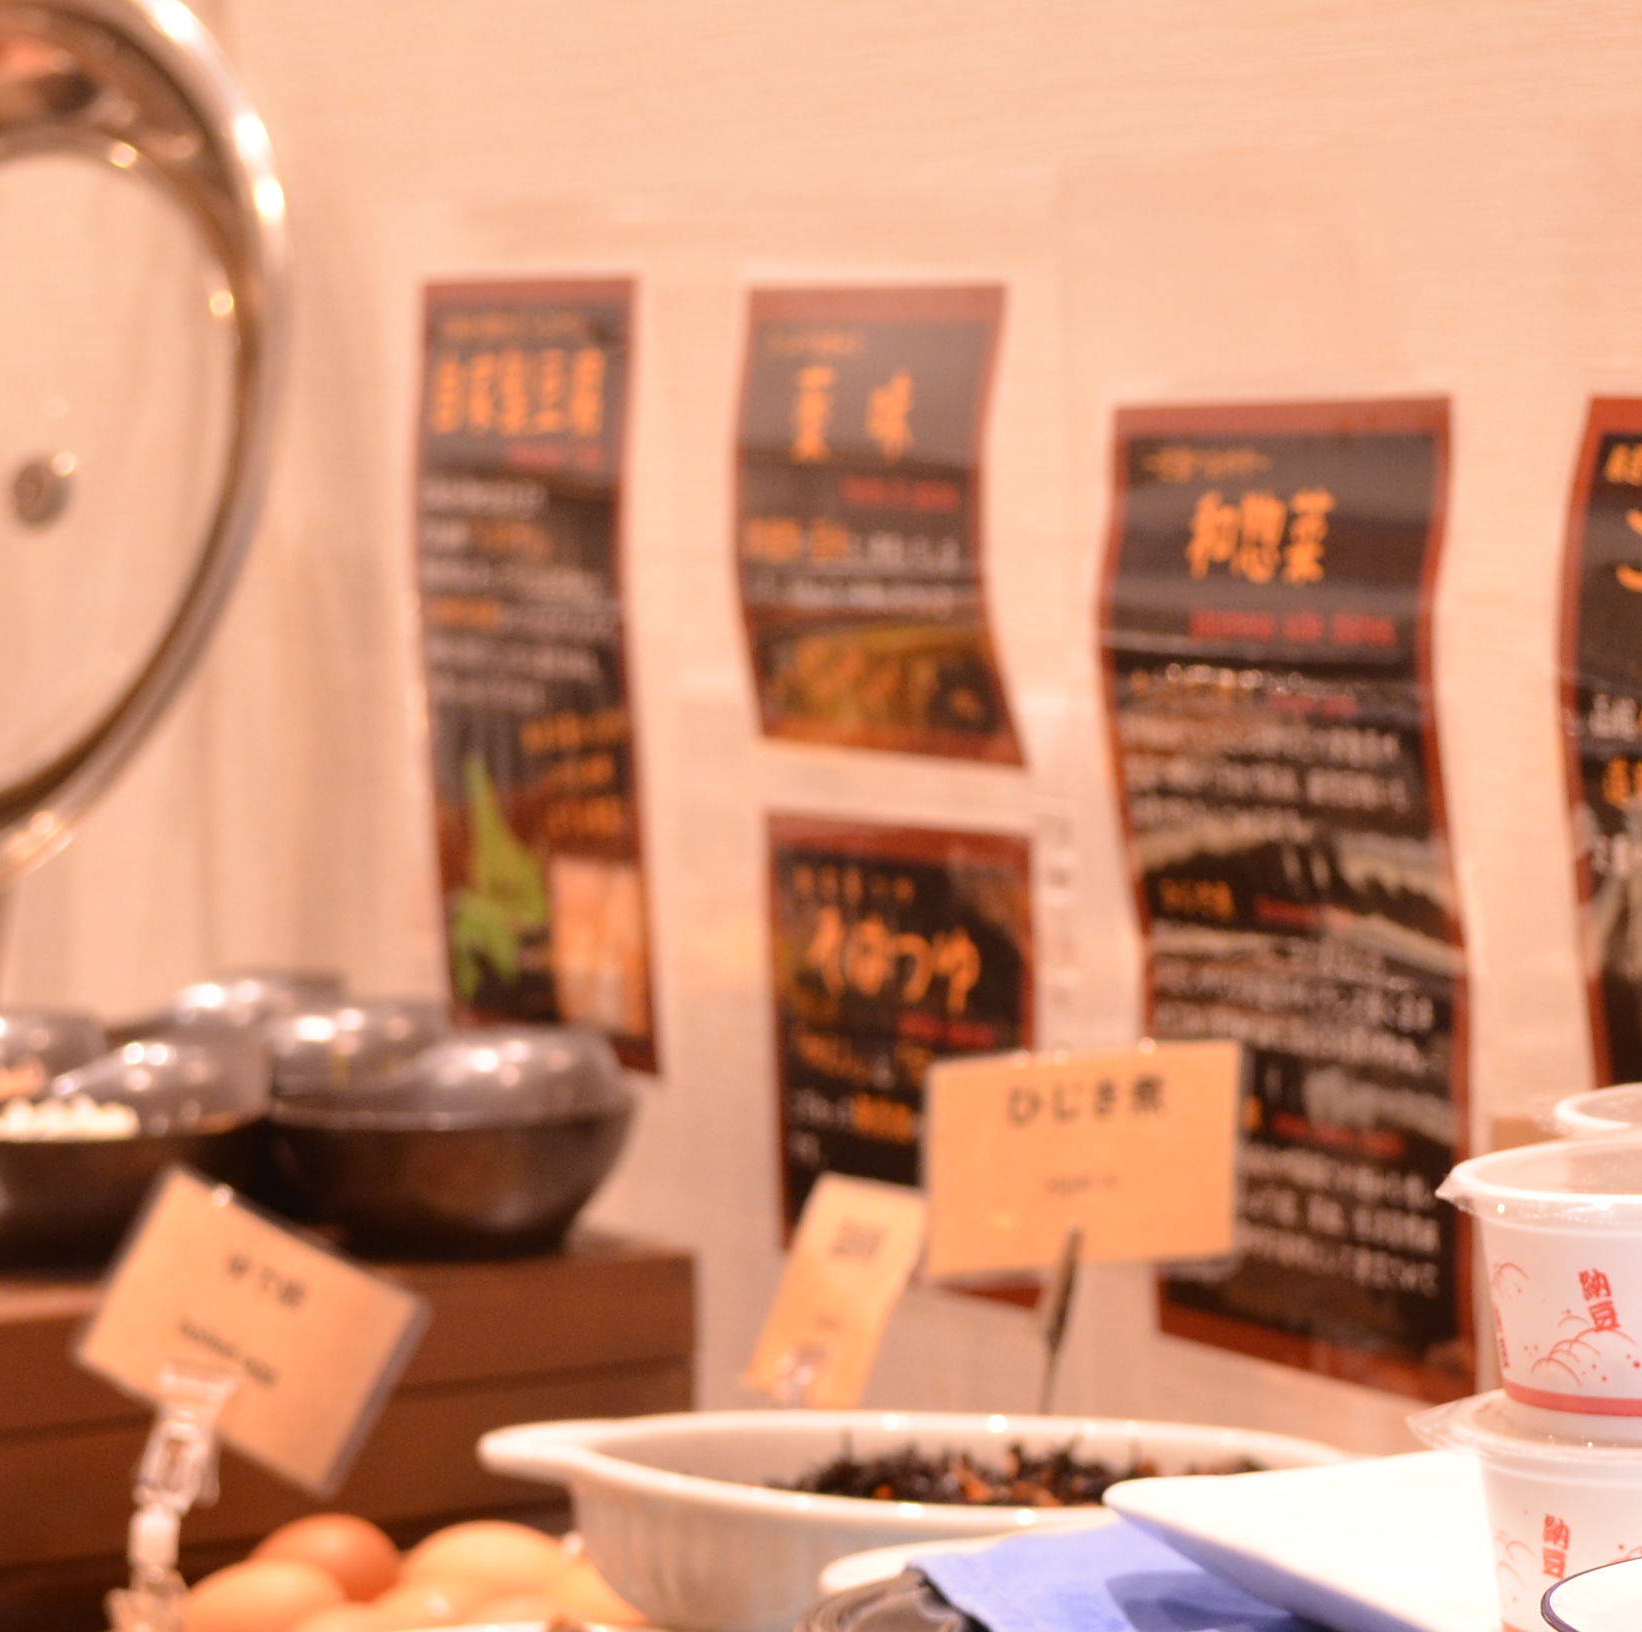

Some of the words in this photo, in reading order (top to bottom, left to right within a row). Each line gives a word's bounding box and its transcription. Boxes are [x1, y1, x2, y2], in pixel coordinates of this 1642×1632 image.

[1007, 1074, 1167, 1126] ひじき煮
[1578, 1267, 1622, 1333] 納豆
[1542, 1513, 1570, 1579] 納豆
